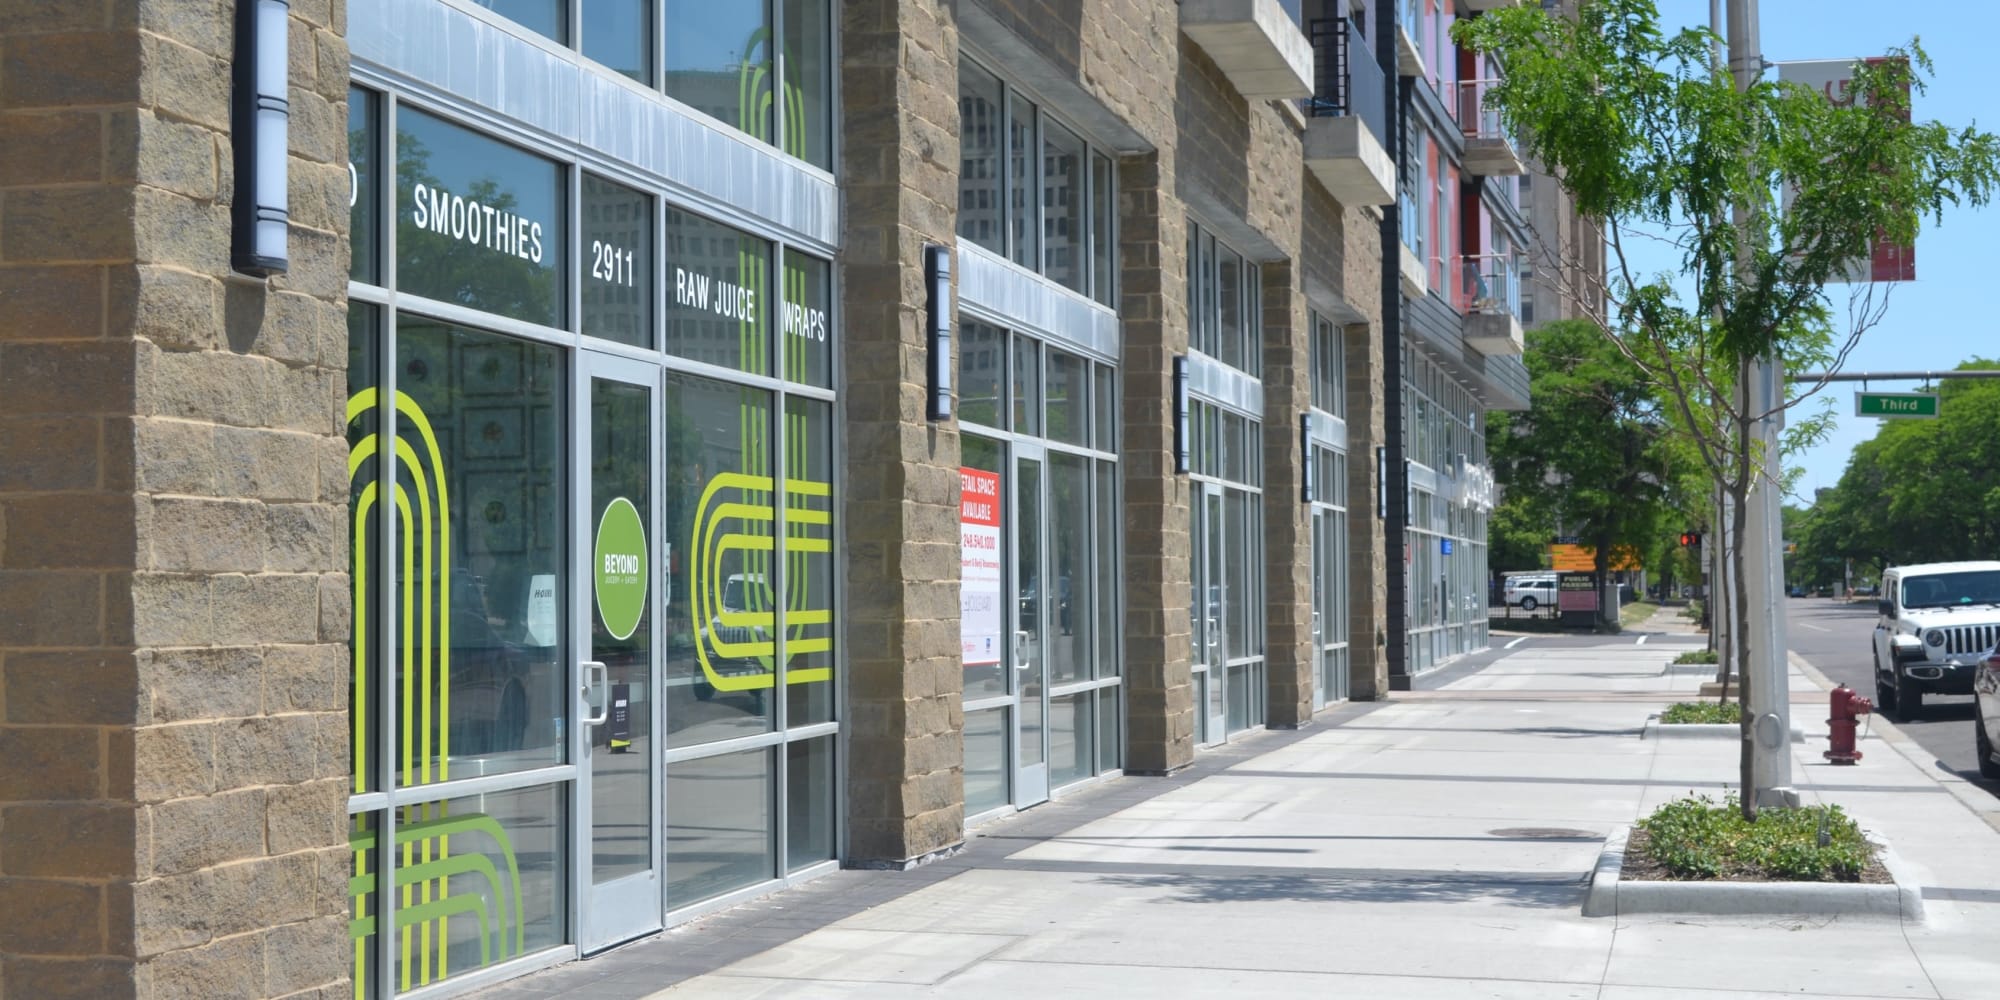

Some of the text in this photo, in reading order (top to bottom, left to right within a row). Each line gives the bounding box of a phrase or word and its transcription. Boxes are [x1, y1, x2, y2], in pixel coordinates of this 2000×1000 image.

[414, 183, 542, 263] SMOOTHIES
[592, 240, 632, 287] 2911
[676, 267, 754, 323] RAW JUICE
[783, 301, 825, 342] WRAPS
[1880, 398, 1918, 411] Third
[961, 474, 996, 496] ETAIL SPACE
[962, 501, 992, 521] AVAILABLE
[604, 553, 639, 574] BEYOND
